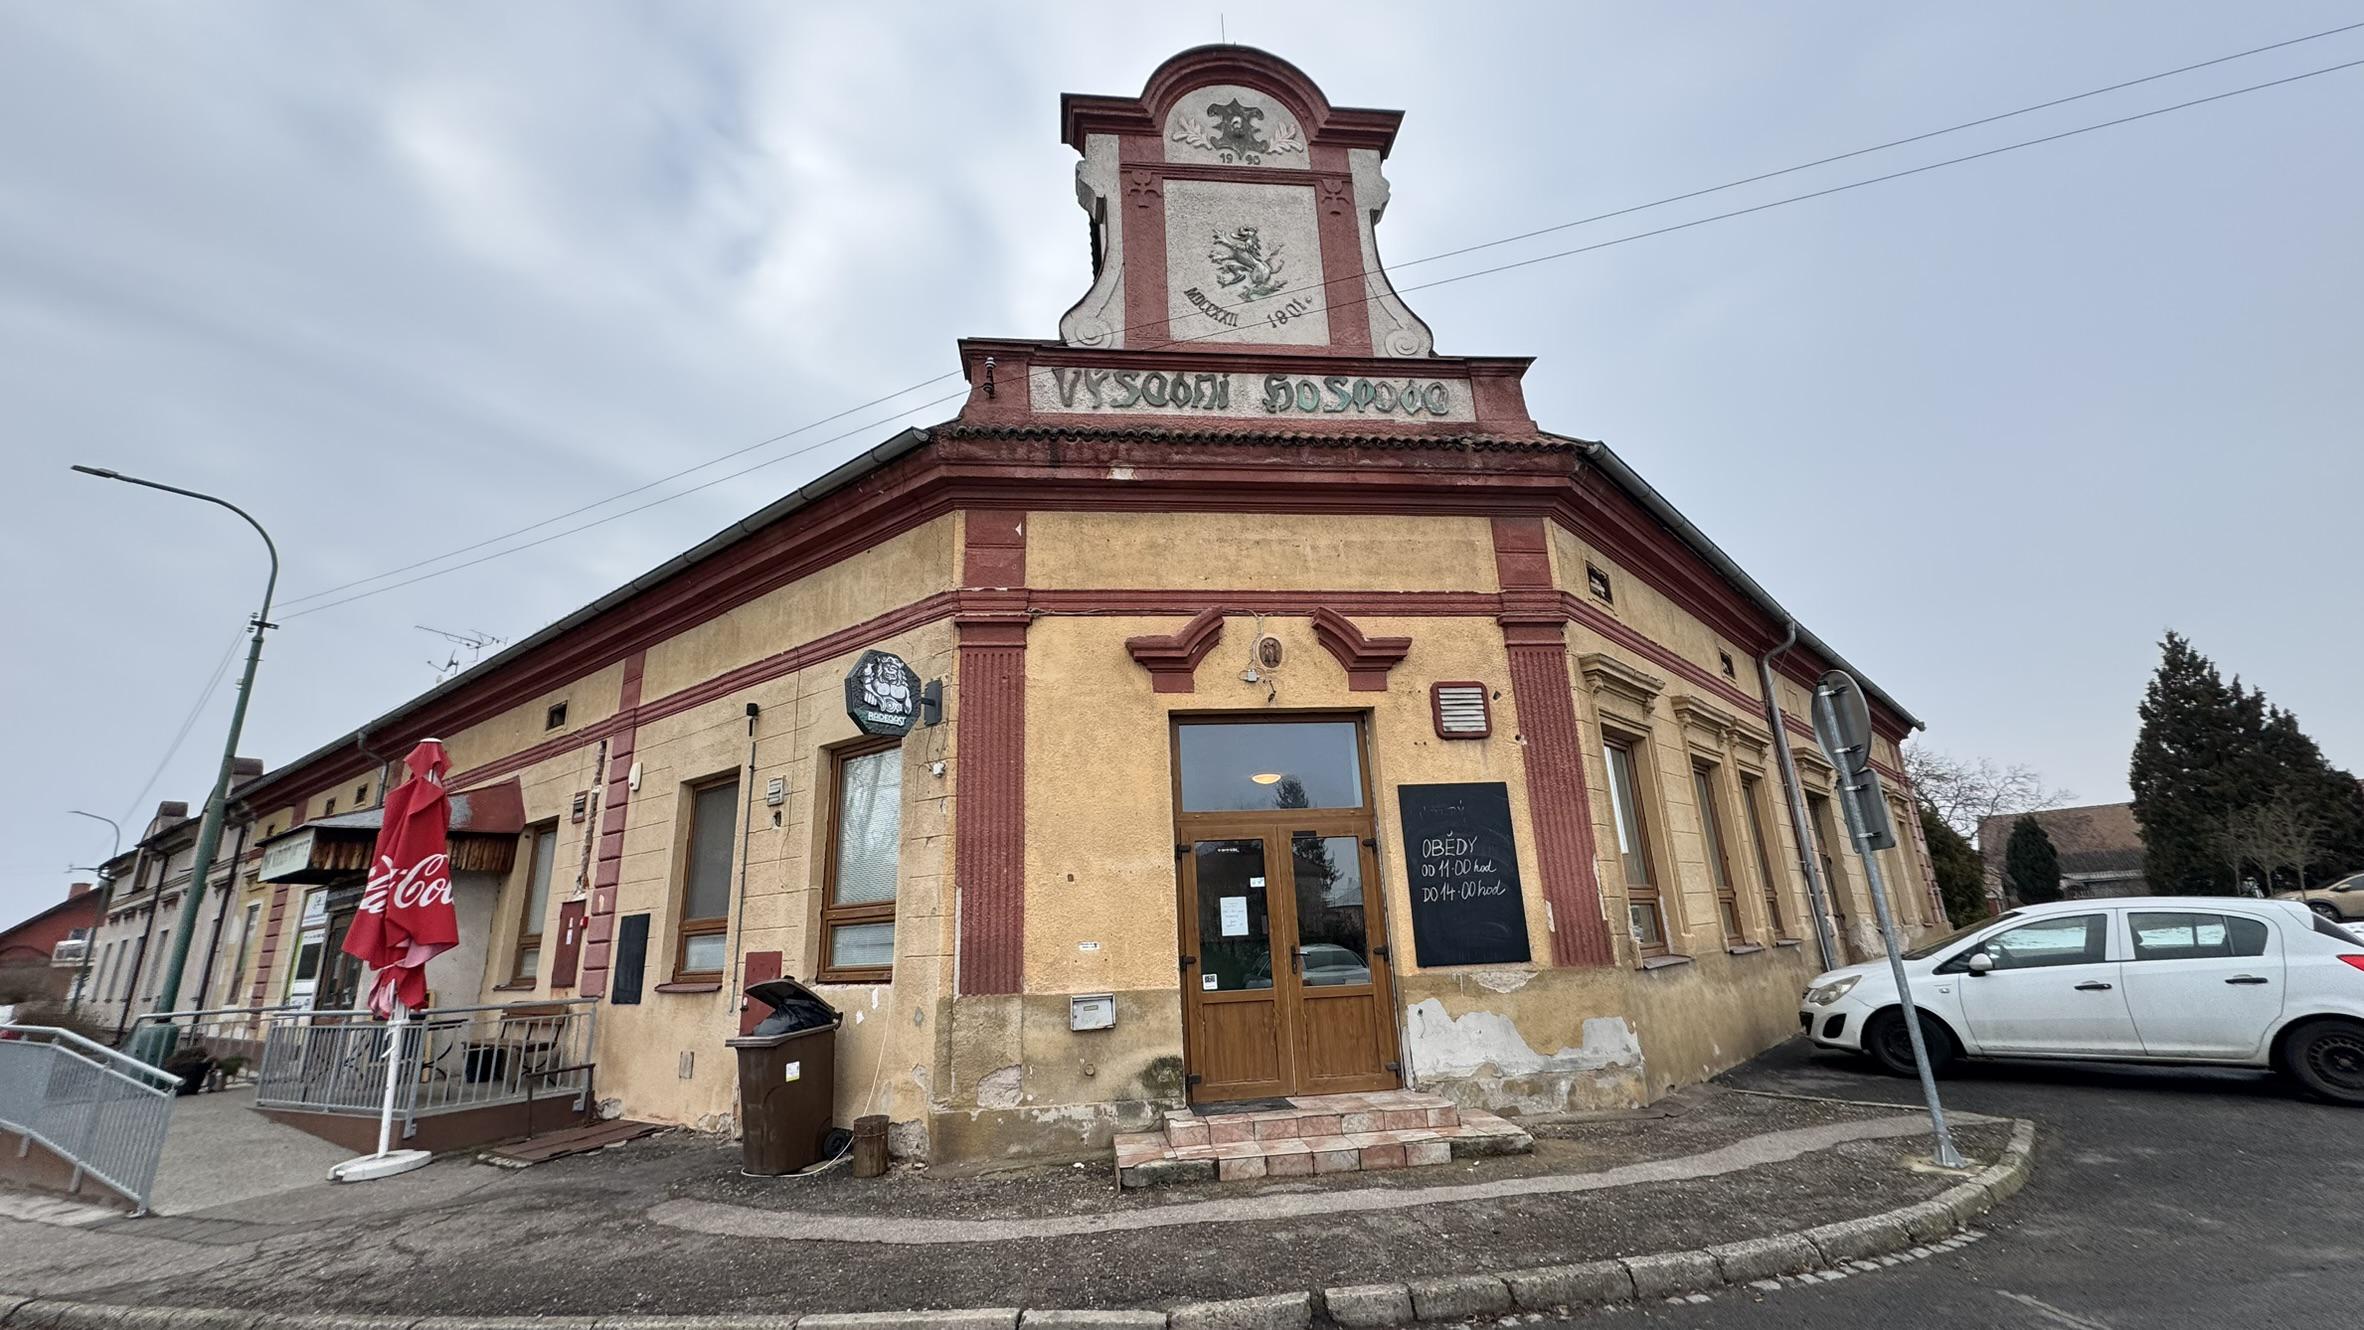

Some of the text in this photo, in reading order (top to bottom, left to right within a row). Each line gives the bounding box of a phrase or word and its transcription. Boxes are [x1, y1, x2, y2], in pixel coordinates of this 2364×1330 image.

[1422, 830, 1478, 858] OBĚDY
[1421, 864, 1436, 877] OD
[1474, 859, 1497, 873] hod
[1422, 886, 1439, 903] DO
[1478, 879, 1506, 897] hod
